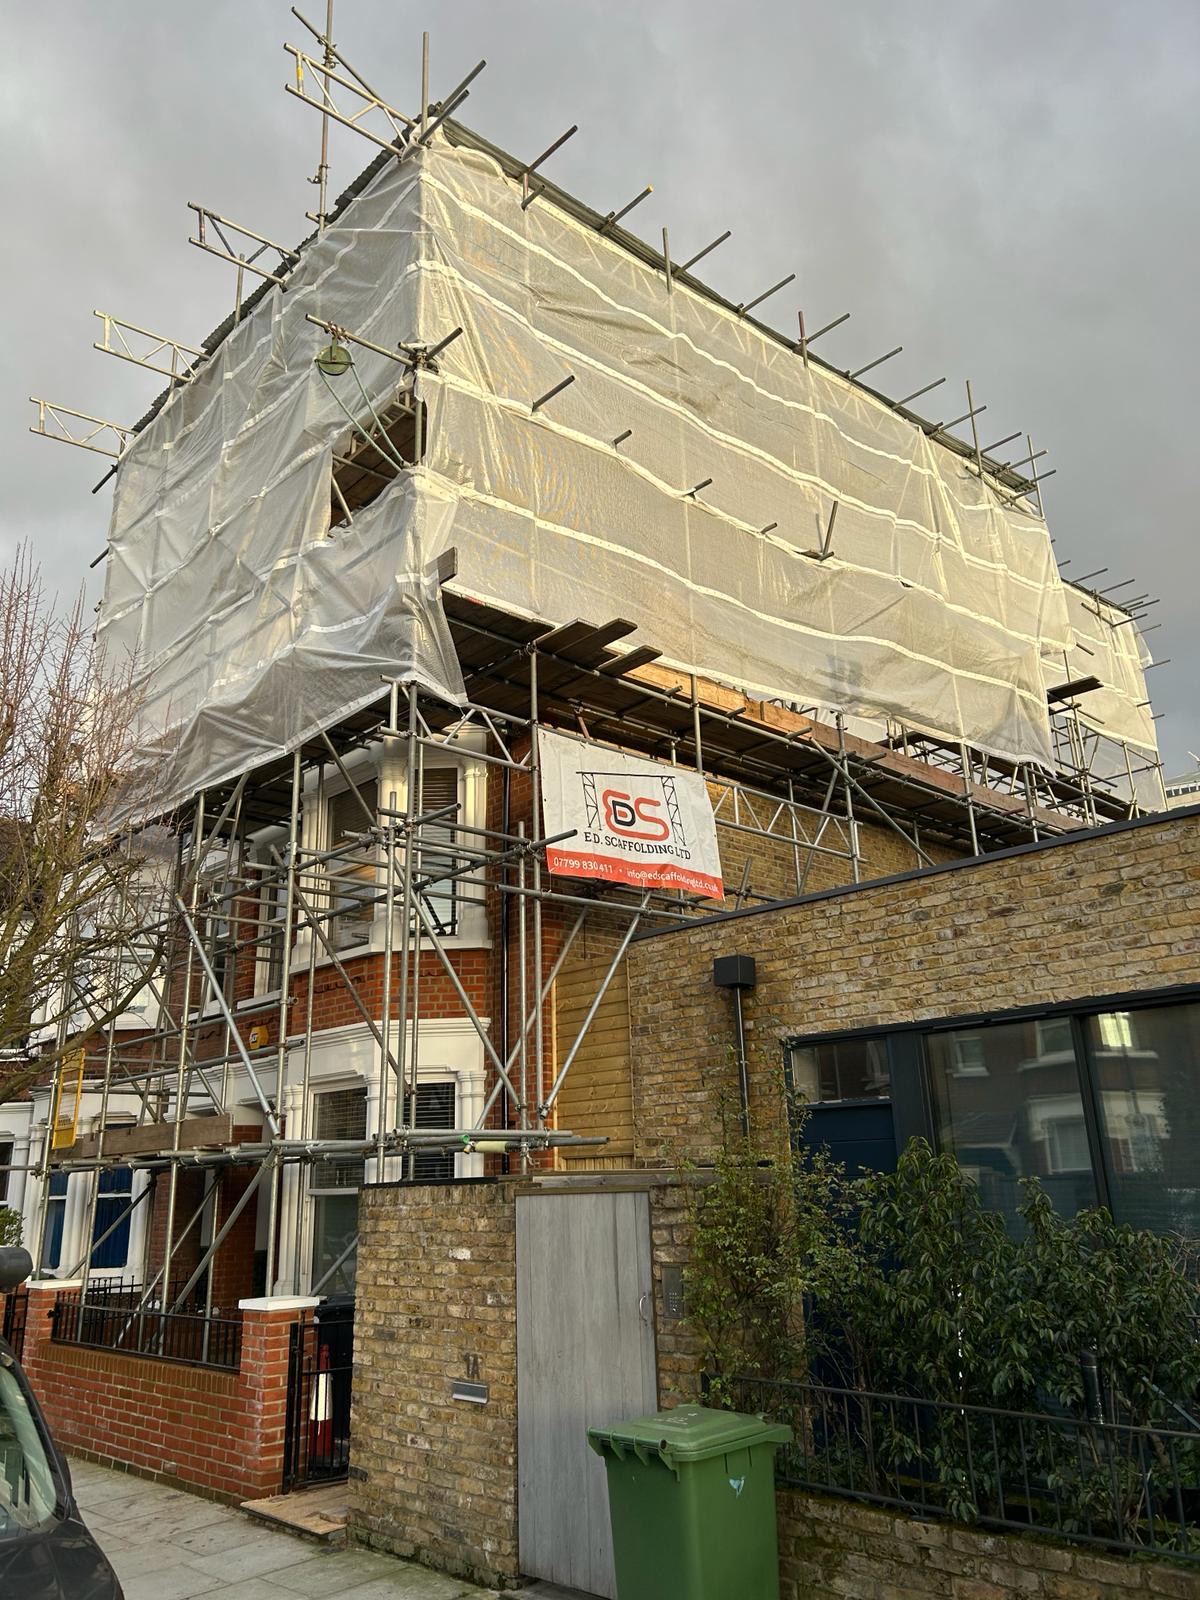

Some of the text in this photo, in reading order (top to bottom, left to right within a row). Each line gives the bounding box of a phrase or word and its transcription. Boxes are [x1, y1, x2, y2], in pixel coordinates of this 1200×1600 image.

[604, 835, 674, 854] SCAFFOLDING
[675, 846, 691, 860] LTD
[553, 856, 580, 868] 07799
[581, 861, 613, 873] 830411
